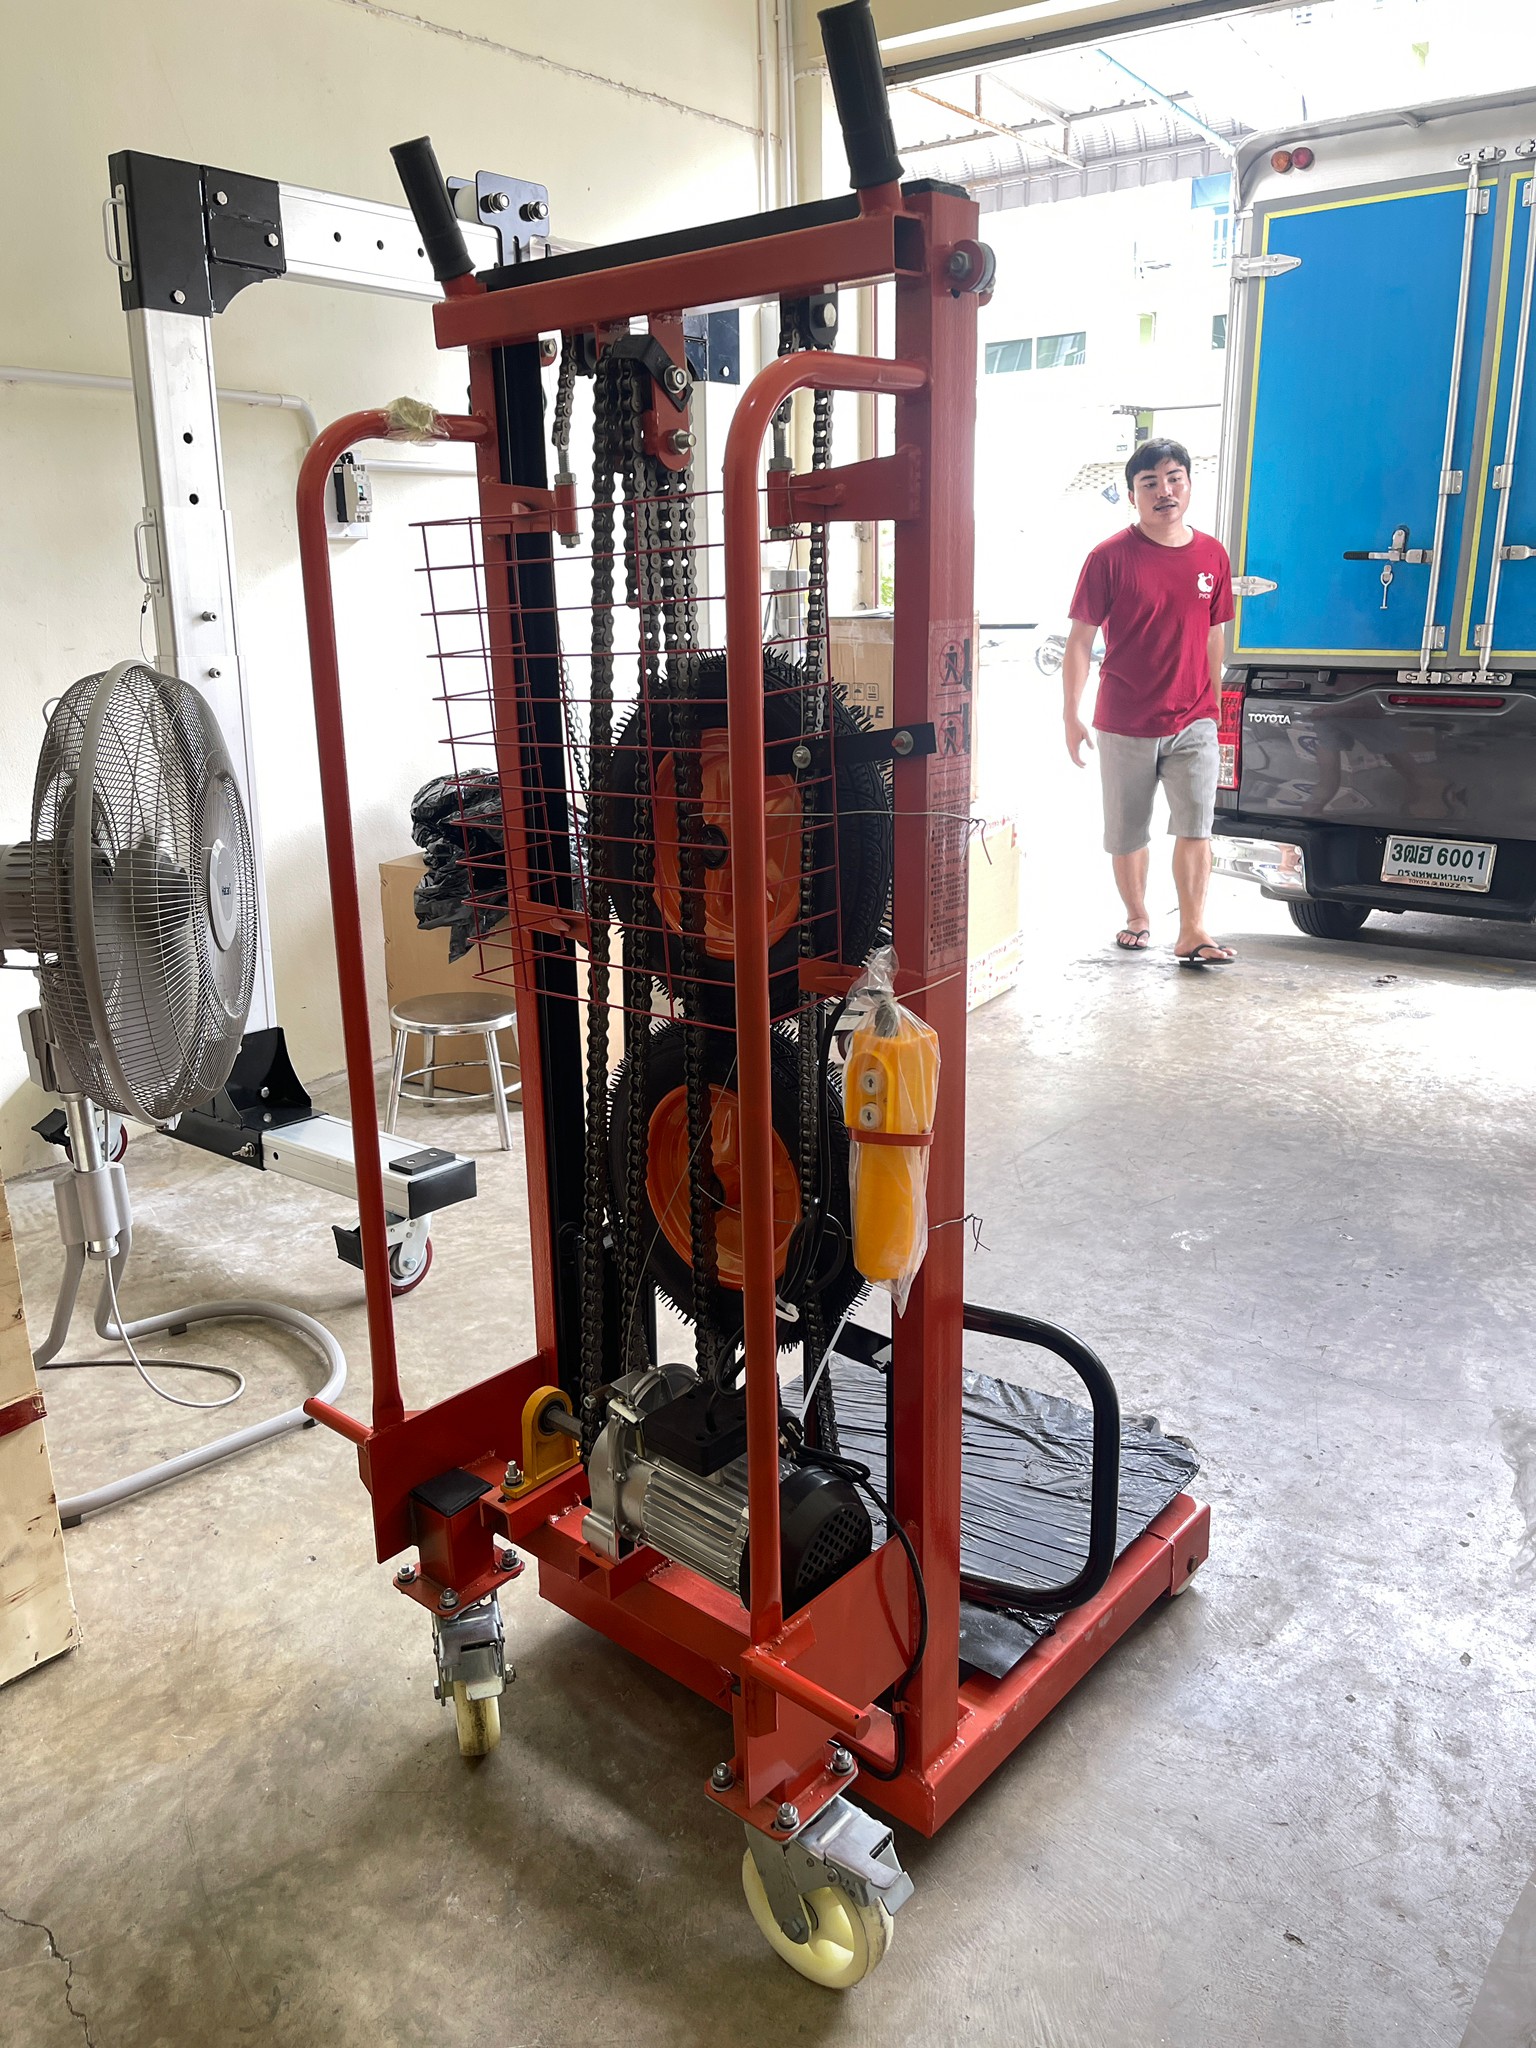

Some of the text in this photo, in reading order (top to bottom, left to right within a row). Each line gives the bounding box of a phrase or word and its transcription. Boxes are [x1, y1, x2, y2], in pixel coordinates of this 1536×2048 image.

[1248, 713, 1291, 724] TOYOTA
[1436, 847, 1486, 870] 6001
[1408, 878, 1430, 886] TOYOTA
